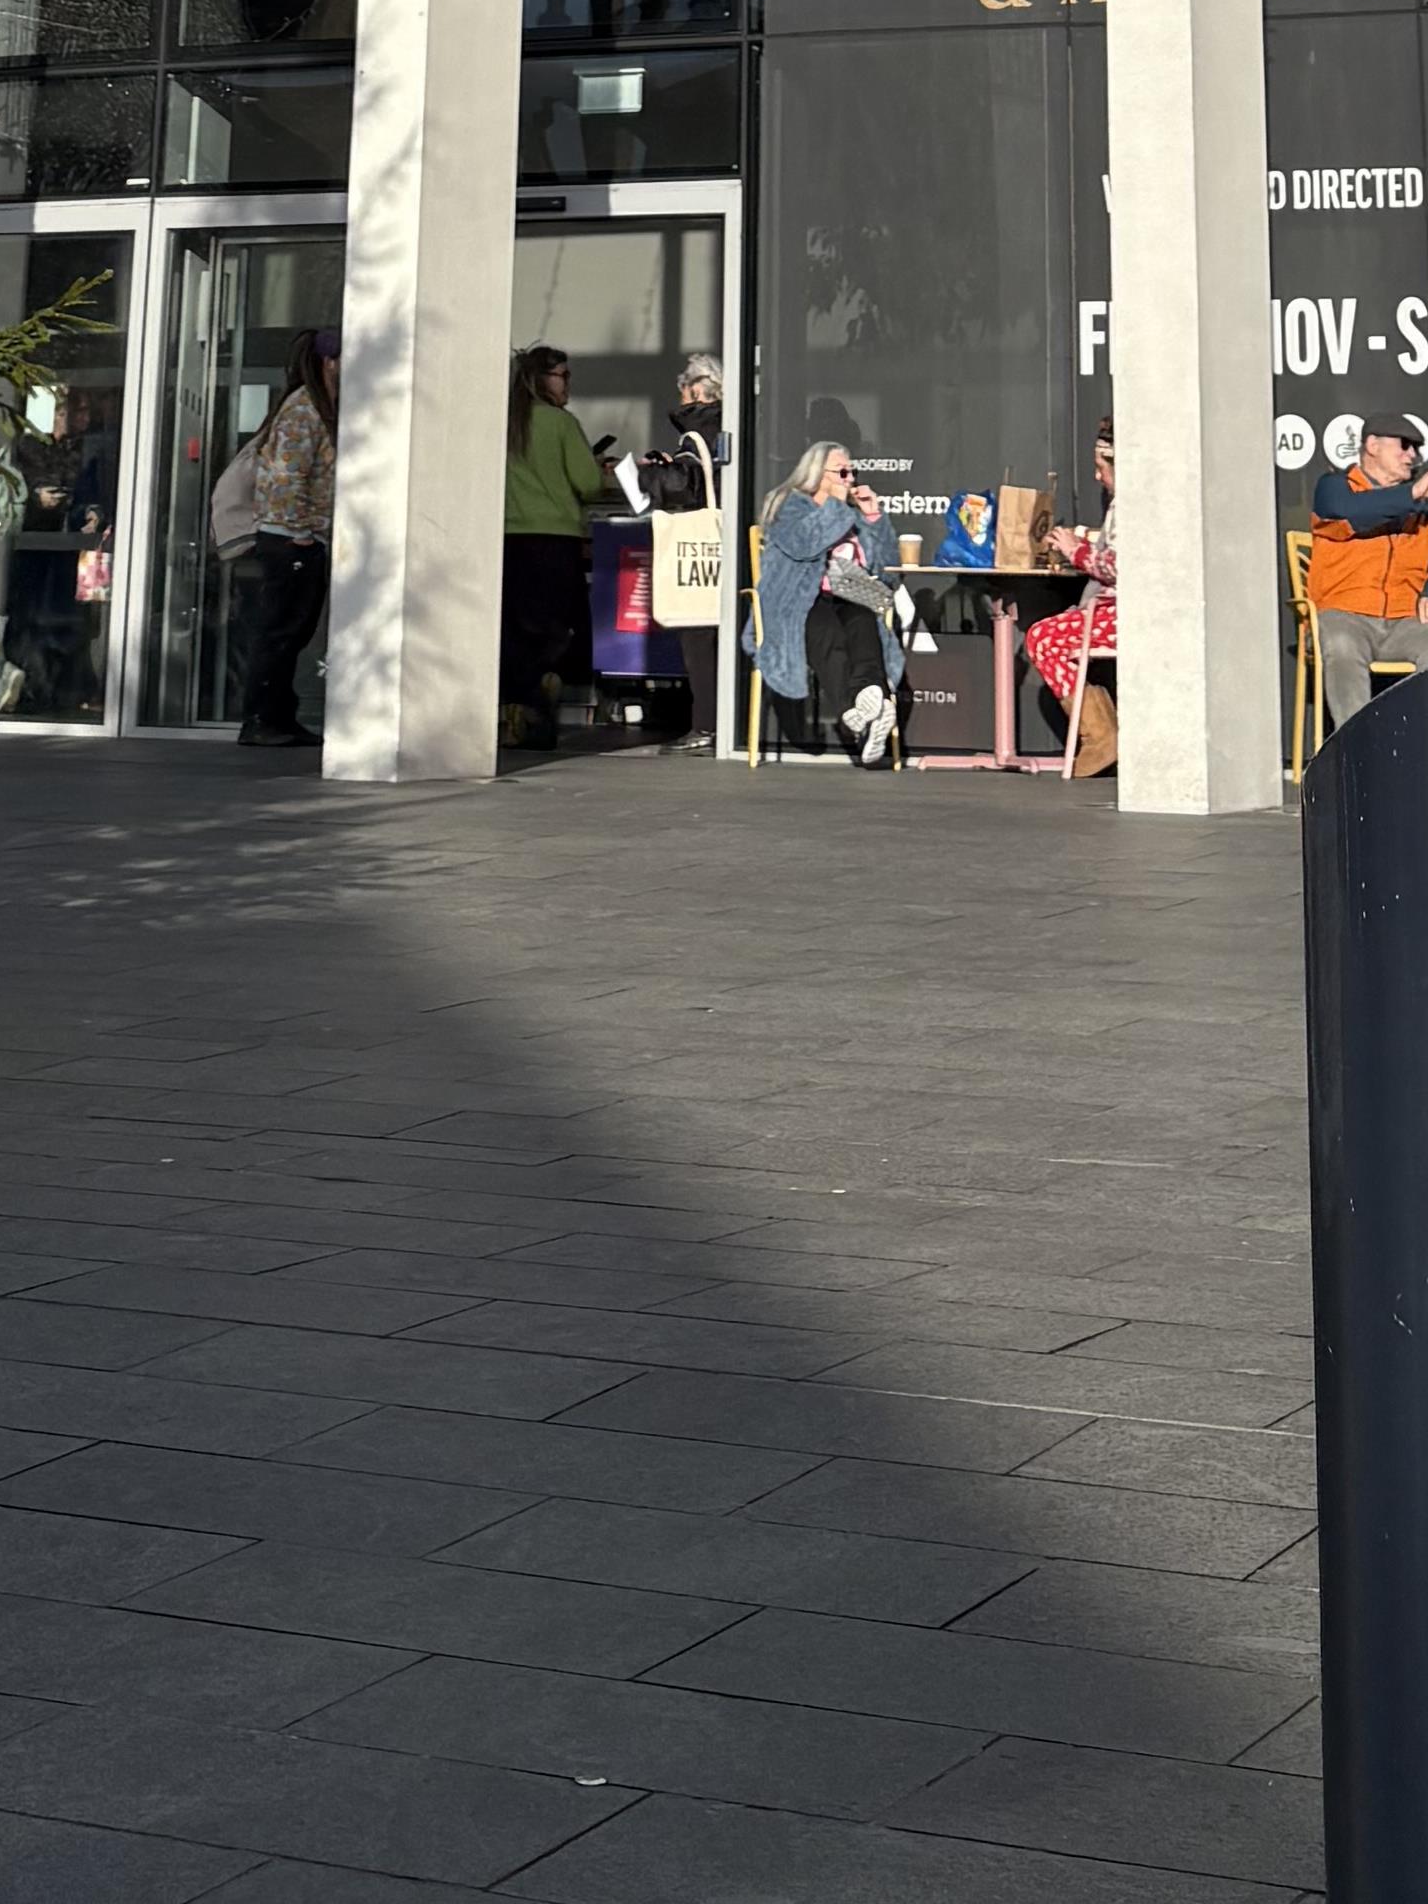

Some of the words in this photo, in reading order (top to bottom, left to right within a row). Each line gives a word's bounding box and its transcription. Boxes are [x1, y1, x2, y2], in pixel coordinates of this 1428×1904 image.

[1293, 166, 1424, 210] DIRECTED
[1277, 432, 1305, 451] AD
[676, 559, 722, 587] LAW
